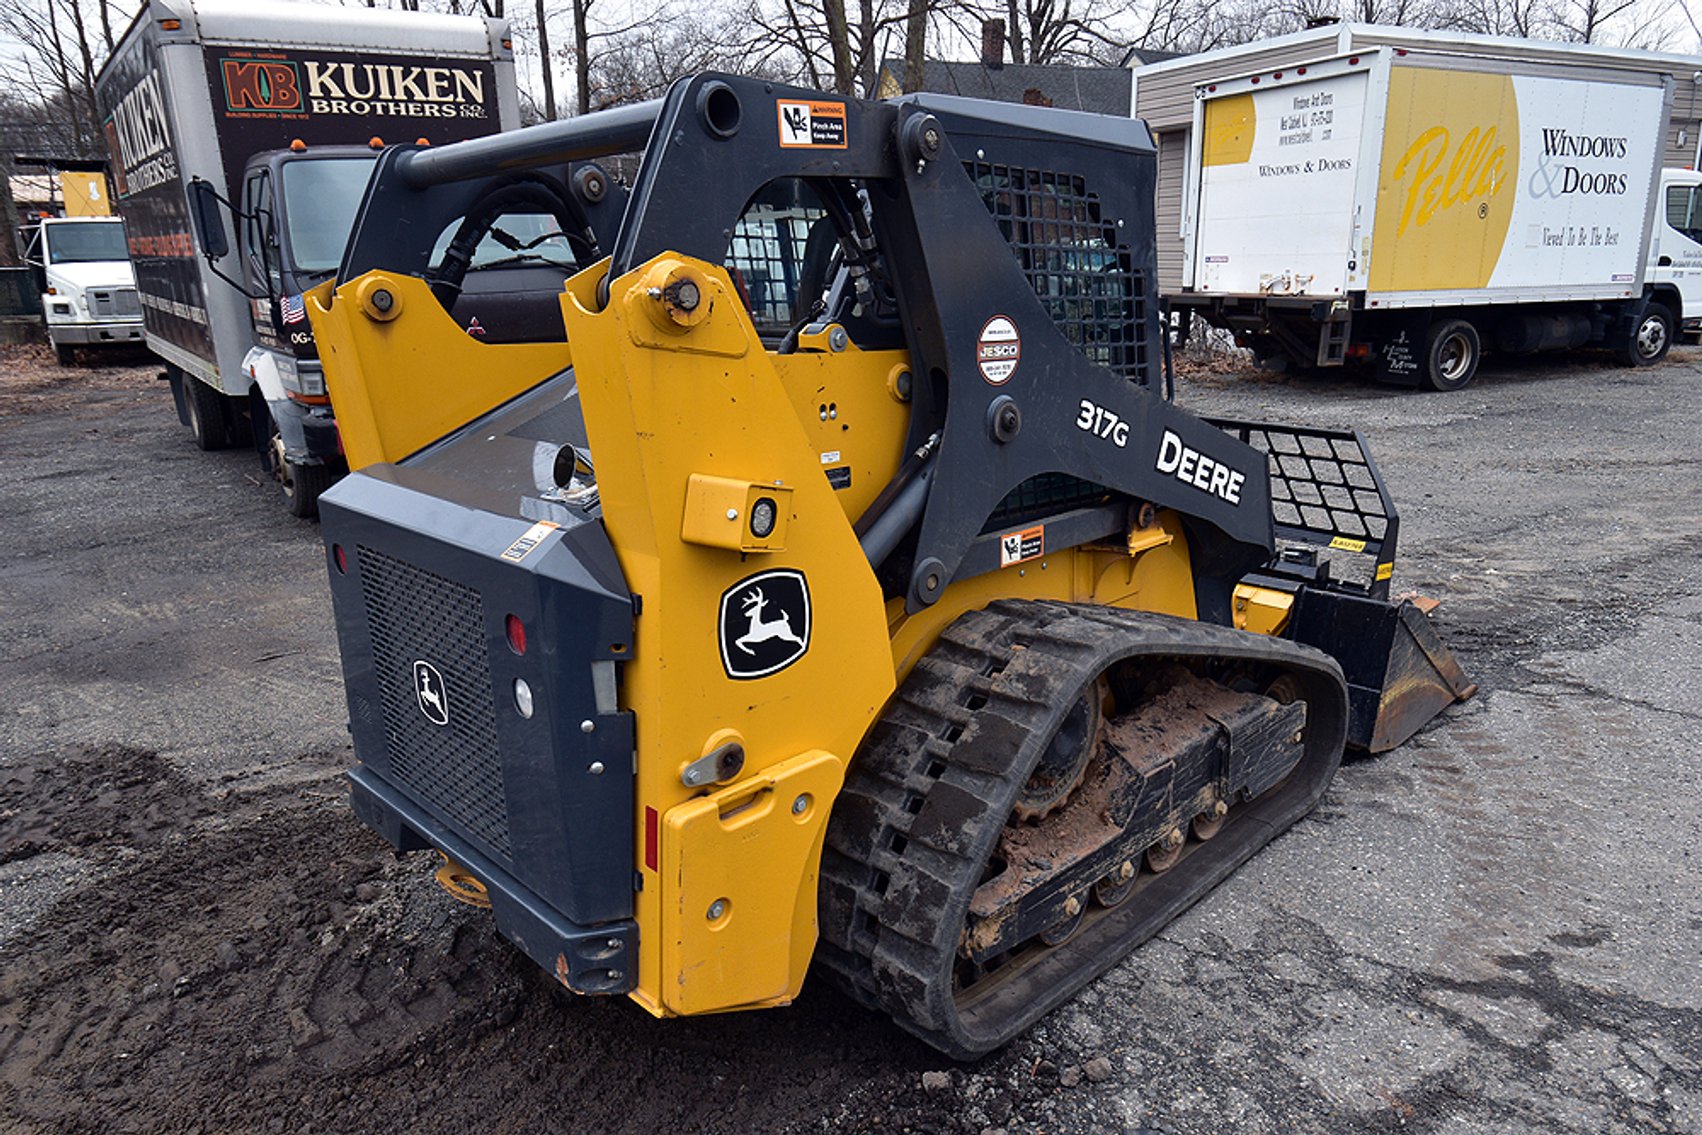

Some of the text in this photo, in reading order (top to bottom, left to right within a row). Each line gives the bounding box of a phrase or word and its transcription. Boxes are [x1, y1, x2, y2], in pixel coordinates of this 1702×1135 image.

[304, 61, 485, 104] KUIKEN
[312, 100, 458, 118] BROTHERS
[1541, 127, 1628, 159] WINDOWS
[1303, 159, 1315, 174] &
[1317, 158, 1352, 173] DOORS
[1392, 124, 1508, 239] Pella
[1561, 166, 1628, 195] DOORS
[980, 344, 1018, 358] JESCO
[1076, 399, 1130, 448] 317G
[1156, 429, 1246, 505] DEERE
